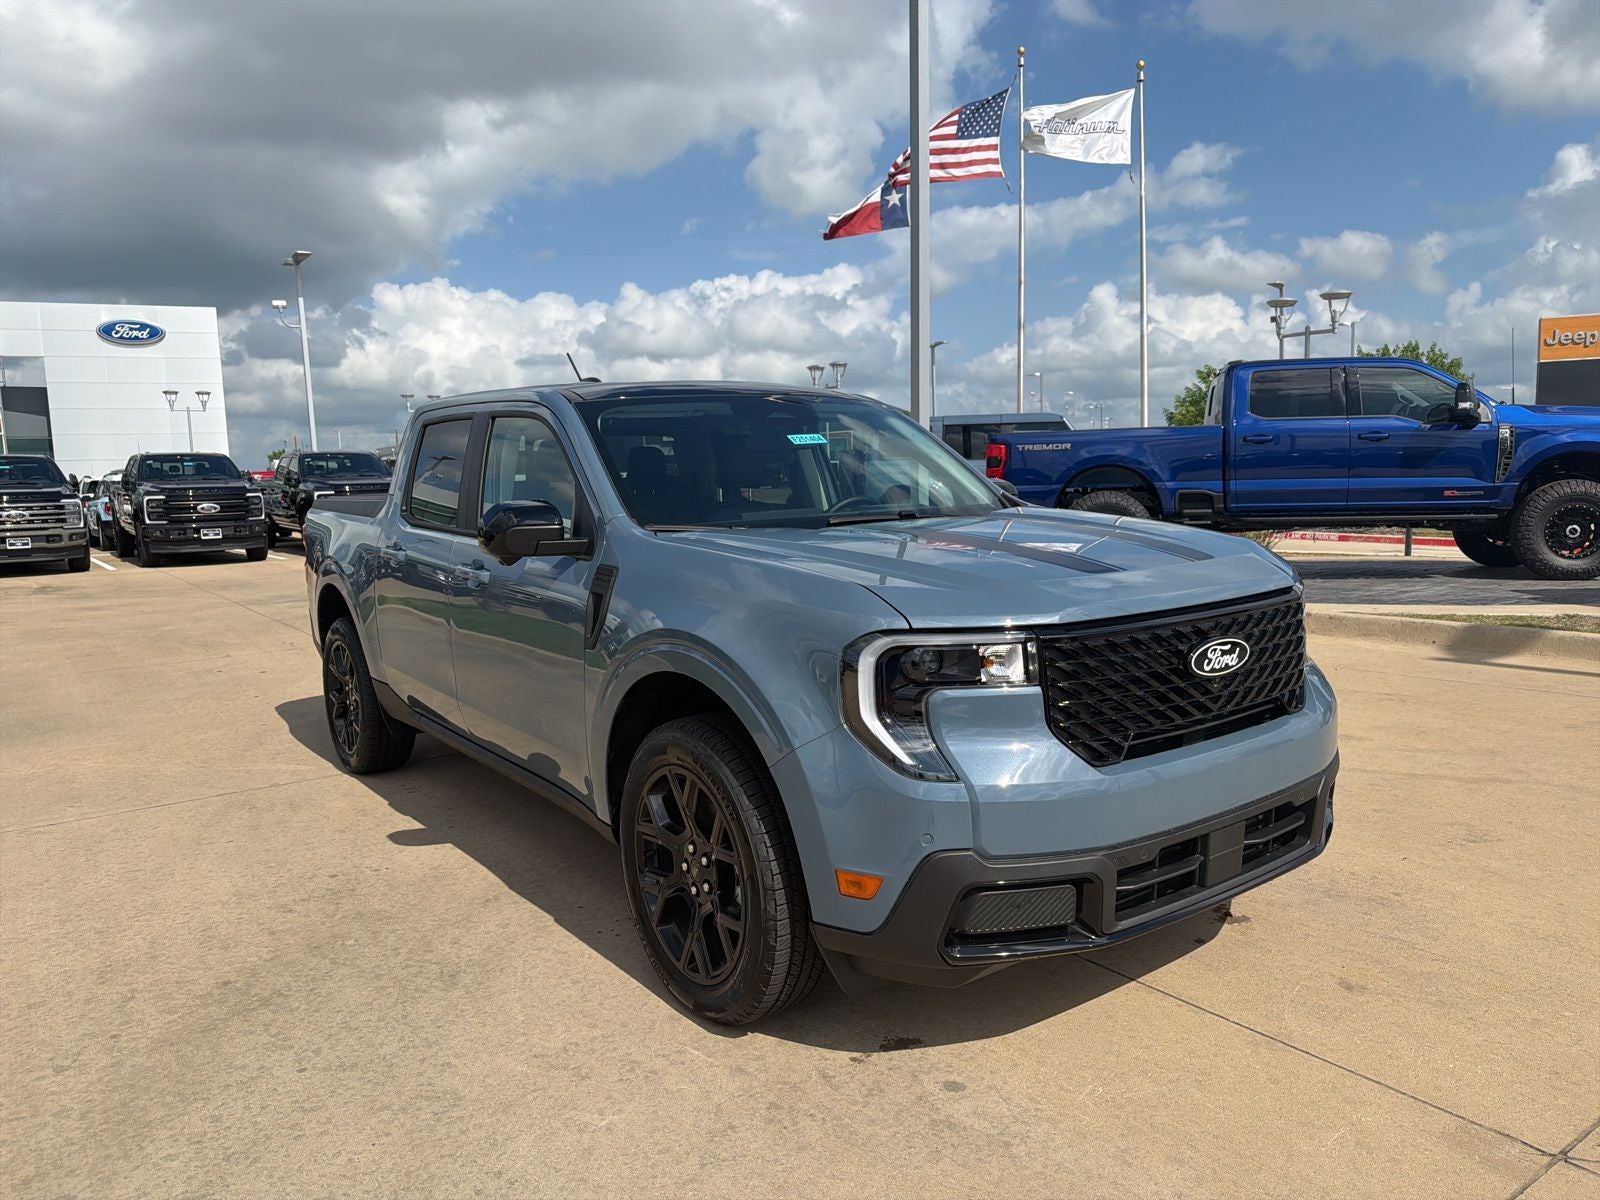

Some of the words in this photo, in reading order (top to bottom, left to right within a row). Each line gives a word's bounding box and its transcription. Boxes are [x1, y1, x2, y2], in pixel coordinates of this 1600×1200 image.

[111, 324, 150, 339] Ford
[1545, 329, 1599, 347] Jeep
[1016, 443, 1071, 451] TREMOR
[1203, 643, 1240, 671] Ford
